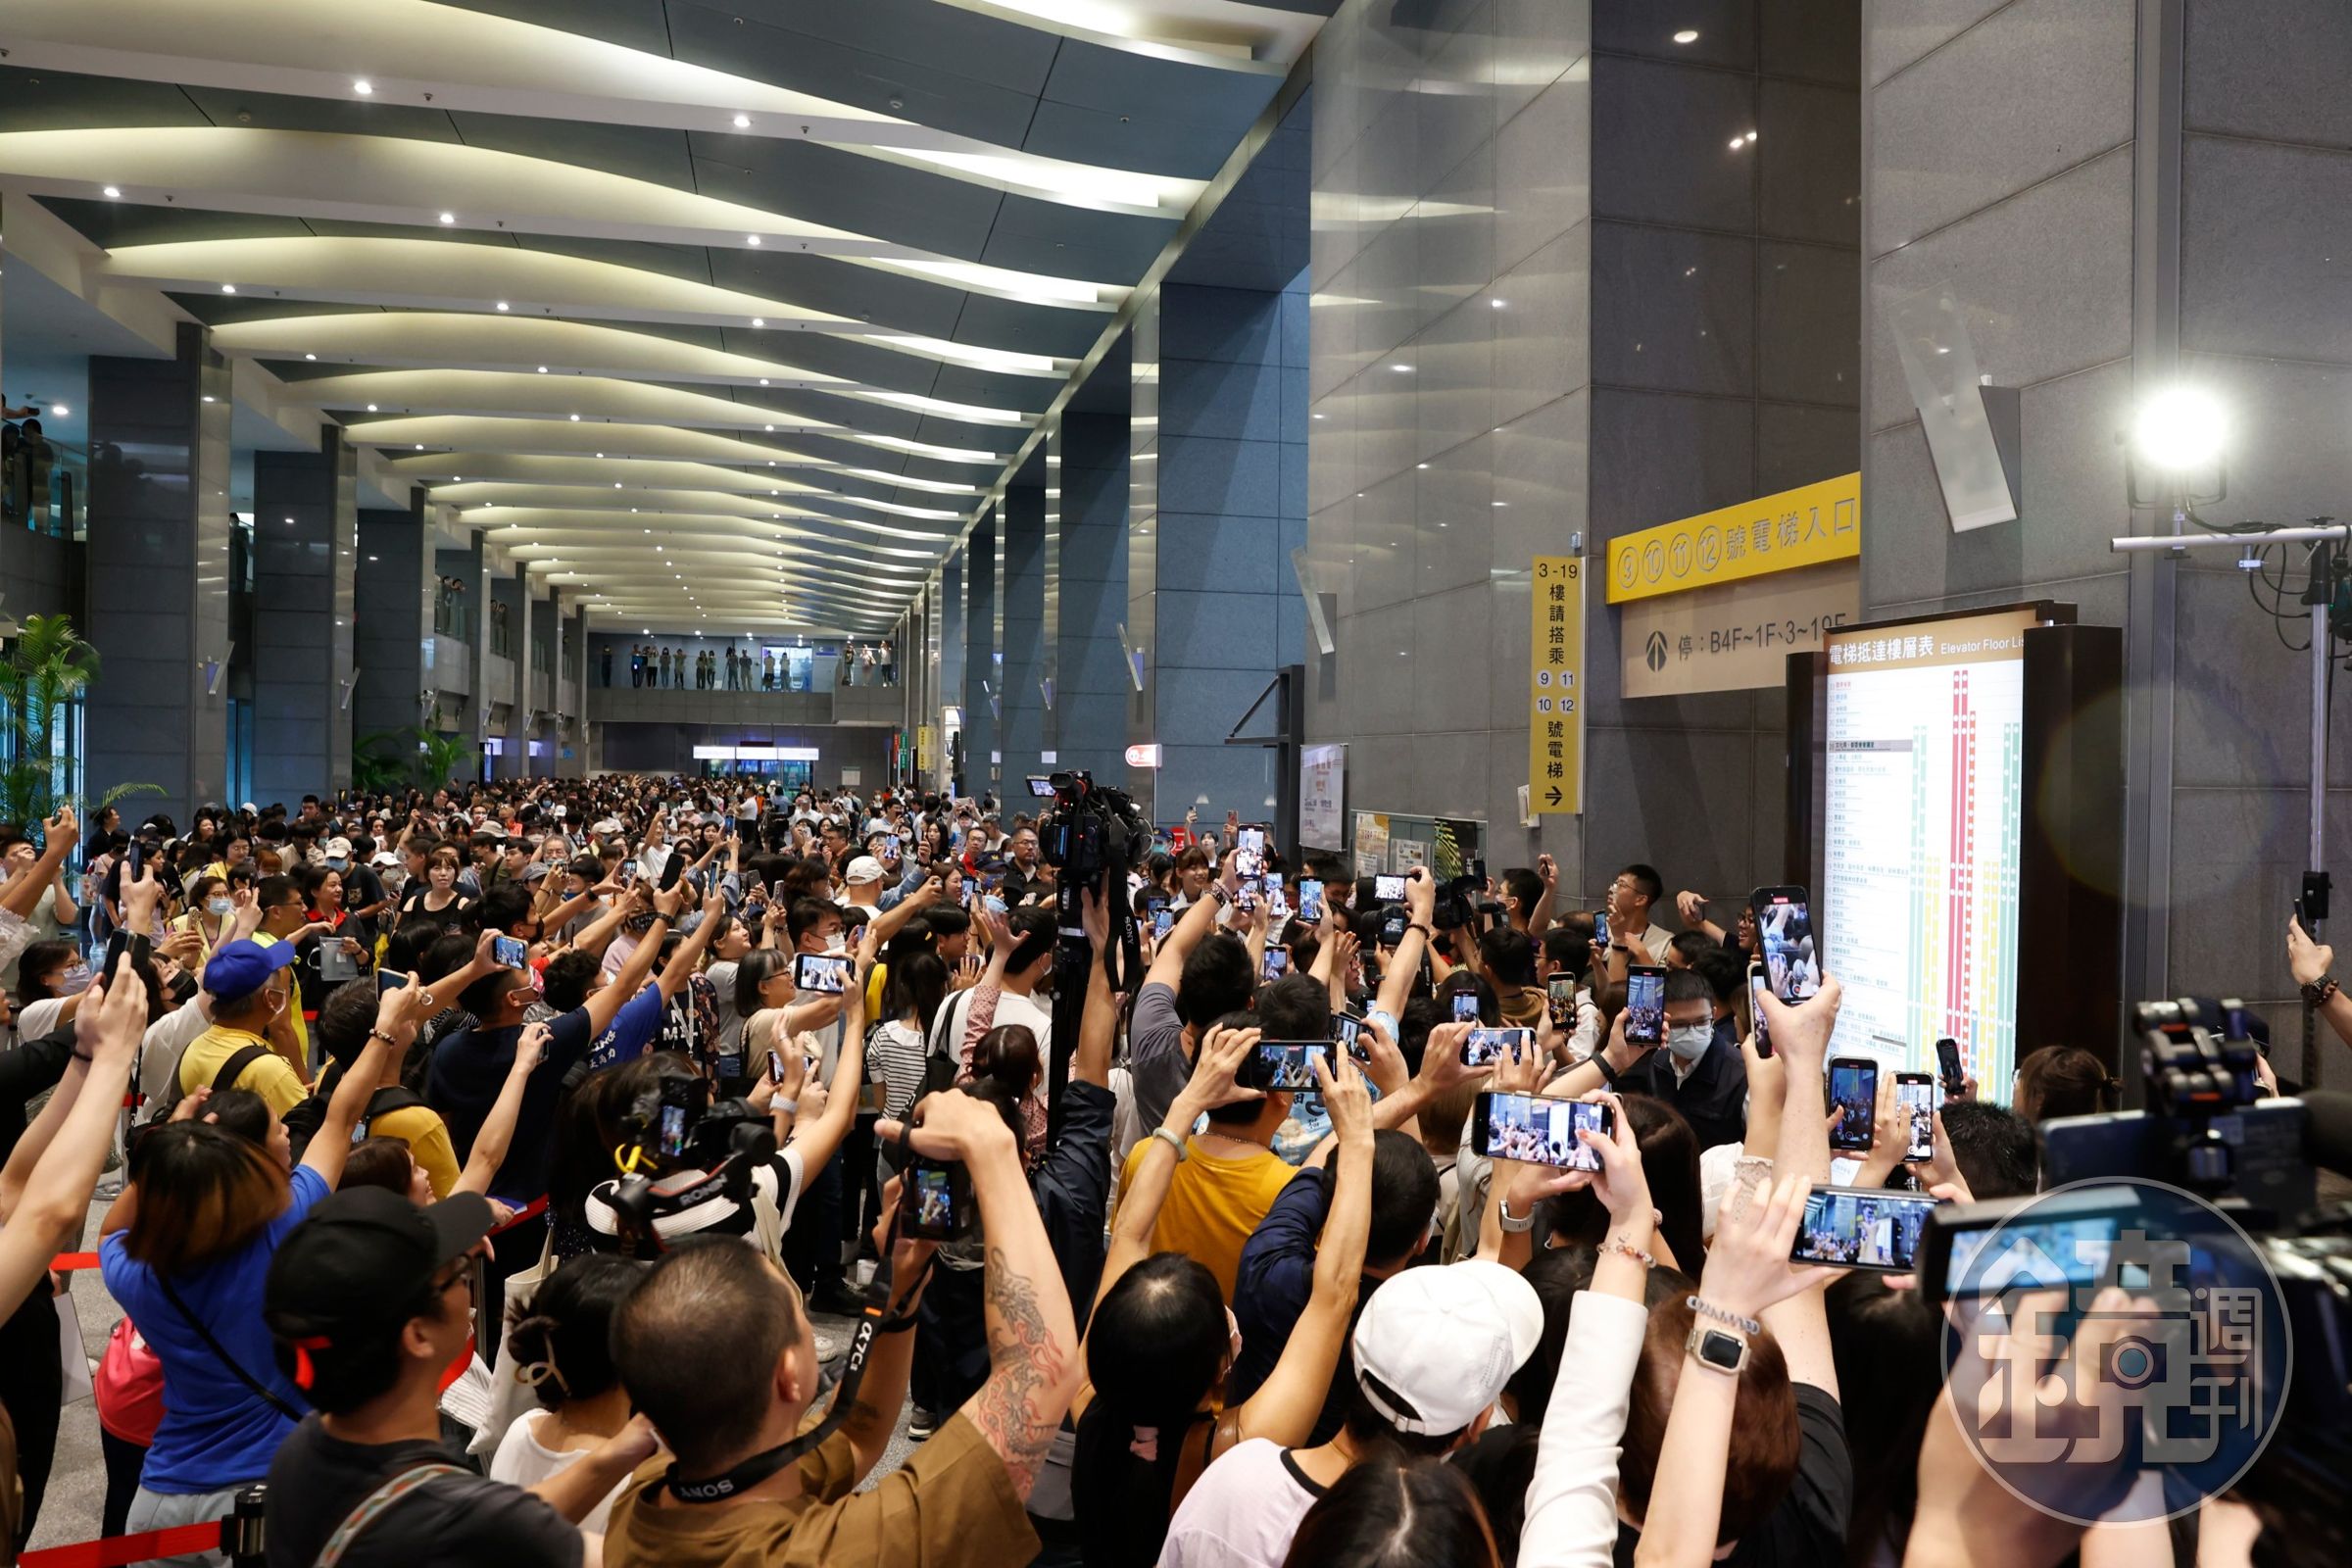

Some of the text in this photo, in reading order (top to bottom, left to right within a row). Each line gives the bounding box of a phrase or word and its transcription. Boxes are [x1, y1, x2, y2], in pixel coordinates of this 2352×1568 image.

[1548, 583, 1565, 664] 樓請搭乘
[1830, 635, 1934, 665] 電梯抵達樓層表
[1940, 641, 1981, 656] Elevator
[1983, 639, 2010, 651] Floor
[1541, 672, 1574, 685] 9 11
[1538, 699, 1574, 711] 10 12
[1547, 721, 1564, 779] 號電梯
[1124, 915, 1135, 946] SONY
[680, 1479, 734, 1498] SONY
